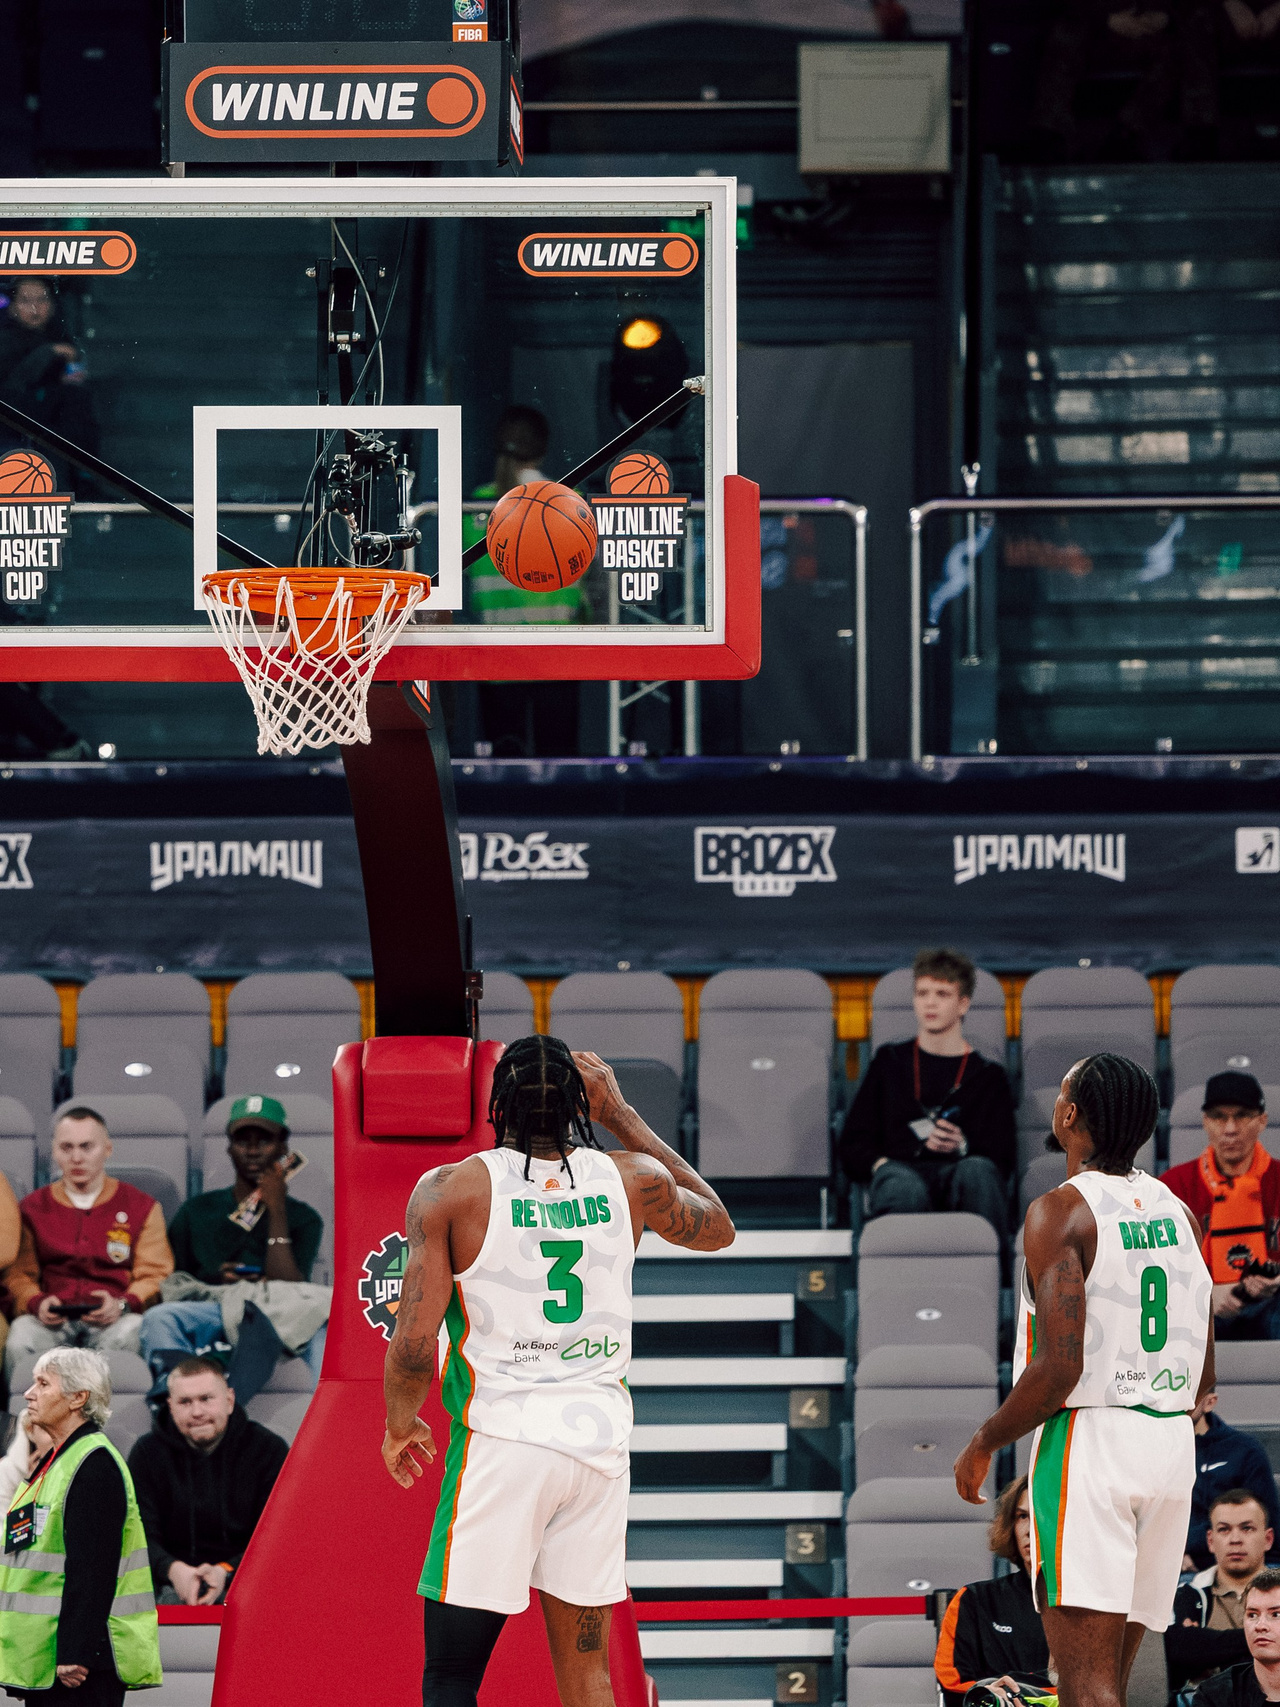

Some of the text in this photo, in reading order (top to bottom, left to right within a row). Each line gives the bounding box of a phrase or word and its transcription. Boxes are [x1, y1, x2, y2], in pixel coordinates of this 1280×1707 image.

[458, 28, 482, 41] FIBA
[212, 82, 418, 121] WINLINE
[533, 243, 658, 267] WINLINE
[596, 506, 684, 535] WINLINE
[603, 539, 677, 568] BASKET
[6, 571, 44, 601] CUP
[621, 572, 659, 601] CUP
[150, 839, 323, 891] УРАЛМАШ
[482, 831, 590, 871] Робек
[698, 829, 834, 880] BROZEX
[952, 833, 1126, 886] УРАЛМАШ
[511, 1194, 612, 1230] REYNOLDS
[1118, 1218, 1179, 1250] BREWER
[539, 1240, 584, 1325] 3
[808, 1271, 825, 1293] 5
[1140, 1265, 1168, 1353] 8
[513, 1340, 559, 1352] Ак Барс
[514, 1353, 541, 1363] Банк
[1115, 1370, 1146, 1382] Ак Барс
[1117, 1384, 1137, 1395] Банк
[800, 1398, 818, 1419] 4
[797, 1533, 815, 1555] 3
[790, 1672, 807, 1694] 2
